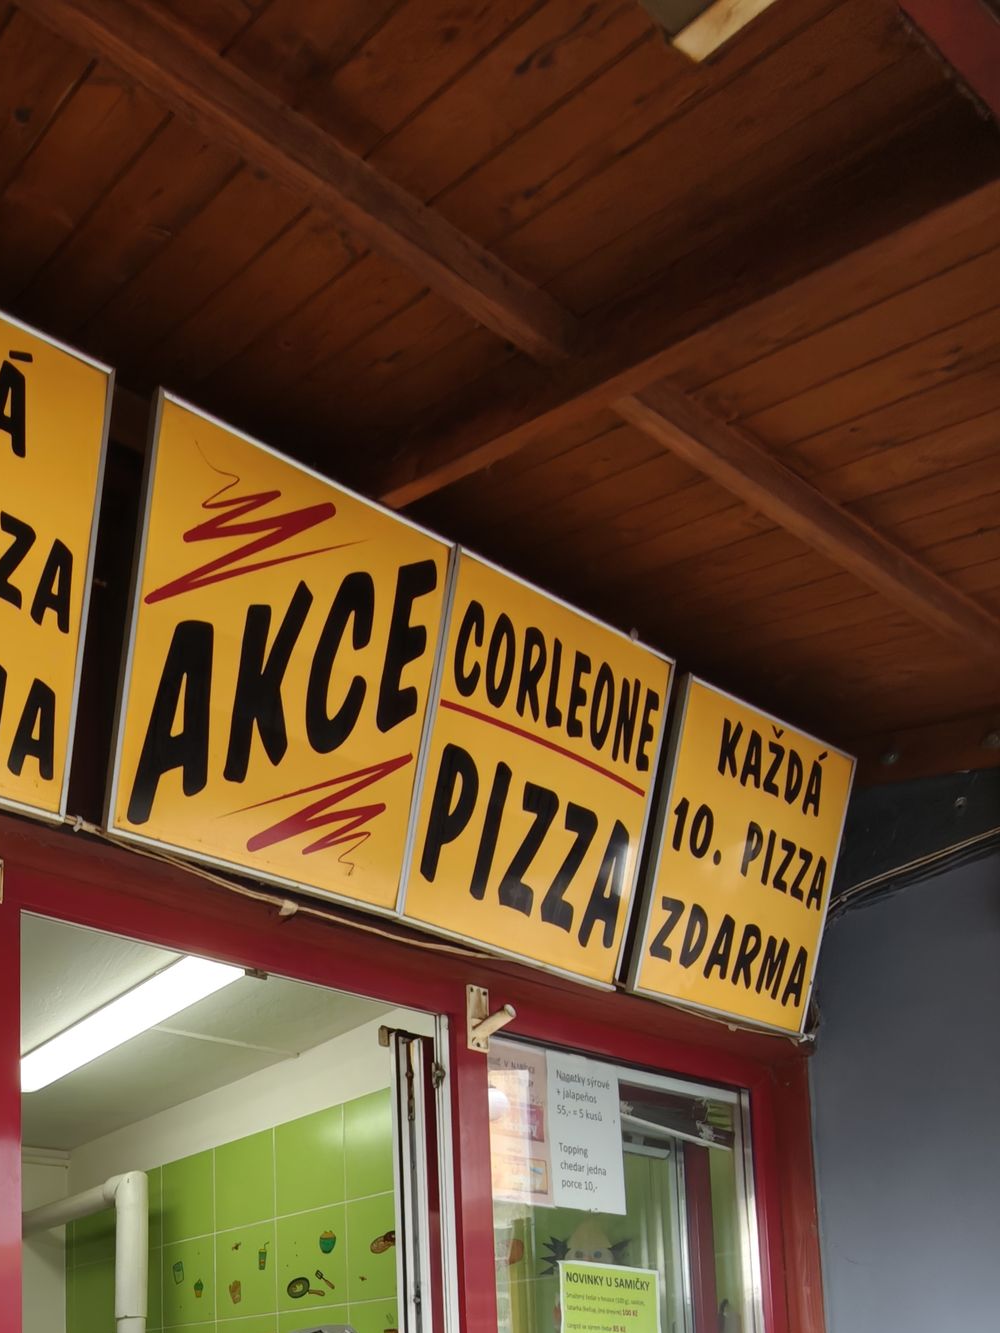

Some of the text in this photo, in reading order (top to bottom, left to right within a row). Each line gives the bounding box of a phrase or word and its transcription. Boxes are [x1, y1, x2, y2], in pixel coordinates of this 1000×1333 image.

[127, 559, 438, 825] AKCE
[454, 600, 659, 772] CORLEONE
[717, 717, 828, 817] KAŽDÁ
[420, 742, 630, 949] PIZZA
[672, 797, 828, 912] 10. PIZZA
[650, 896, 809, 1008] ZDARMA
[586, 1076, 610, 1090] sýrové
[579, 1109, 584, 1118] 5
[585, 1109, 603, 1122] kusů
[558, 1142, 588, 1158] Topping
[560, 1159, 607, 1176] chedar jedna
[561, 1177, 583, 1190] porce
[566, 1272, 650, 1291] NOVINKY U SAMIČKY
